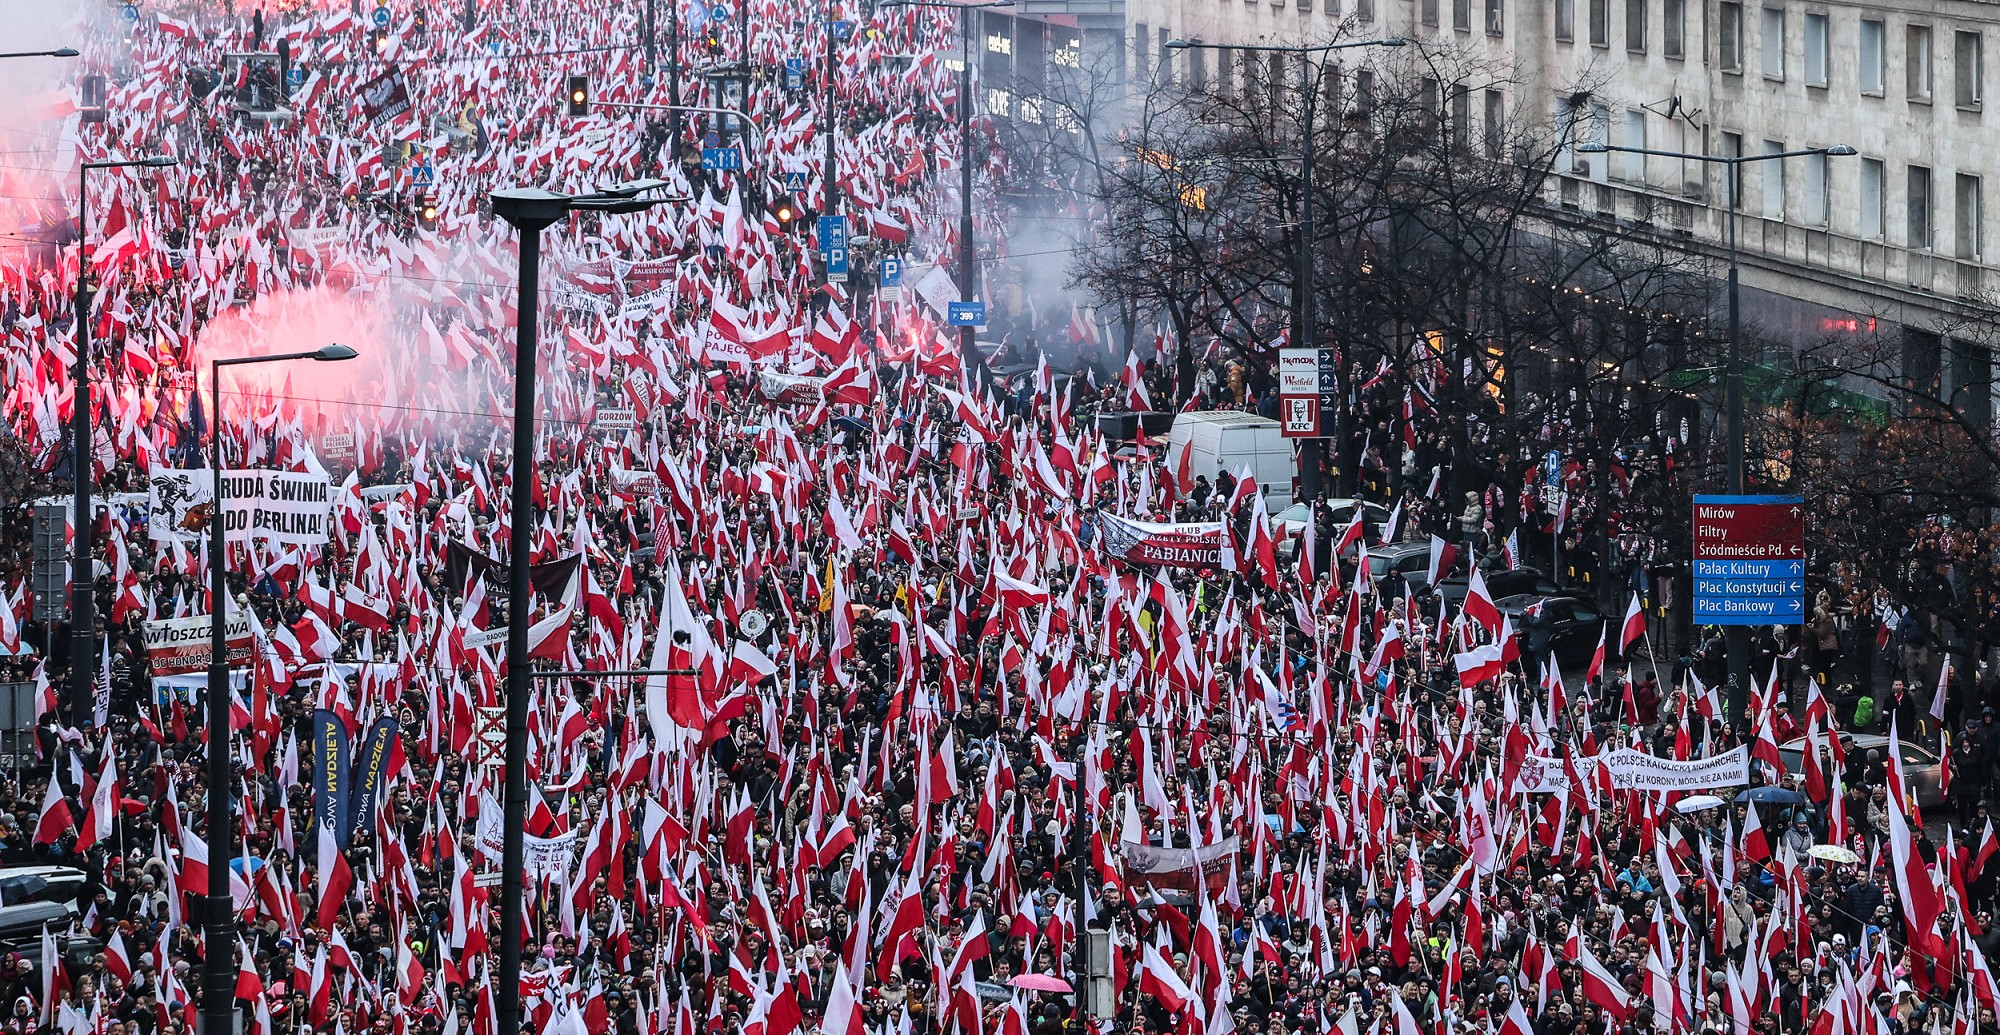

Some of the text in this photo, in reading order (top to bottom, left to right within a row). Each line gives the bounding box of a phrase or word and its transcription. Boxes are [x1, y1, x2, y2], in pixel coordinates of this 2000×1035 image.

[959, 312, 974, 321] 399
[1284, 375, 1314, 386] Westfield
[598, 411, 633, 421] GORZÓW
[1290, 422, 1310, 430] KFC
[220, 475, 327, 503] RUDA ŚWINIA
[1699, 507, 1735, 519] Mirów
[225, 508, 322, 535] DO BERLINA!
[1699, 525, 1728, 540] Filtry
[1185, 535, 1221, 545] POLSKI
[1699, 542, 1785, 556] Śródmieście Pd.
[1699, 562, 1771, 578] Pałac Kultury
[1699, 581, 1786, 595] Plac Konstytucji
[1699, 599, 1775, 614] Plac Bankowy
[146, 621, 250, 645] WŁOSZCZWA
[168, 655, 200, 668] HONOR
[364, 726, 389, 791] NADZIEJA
[1616, 755, 1645, 767] POLSCE
[1691, 752, 1741, 772] MONARCHIĘ!
[1646, 775, 1678, 787] KORONY,
[1700, 774, 1711, 785] SIĘ
[1712, 772, 1722, 782] ZA
